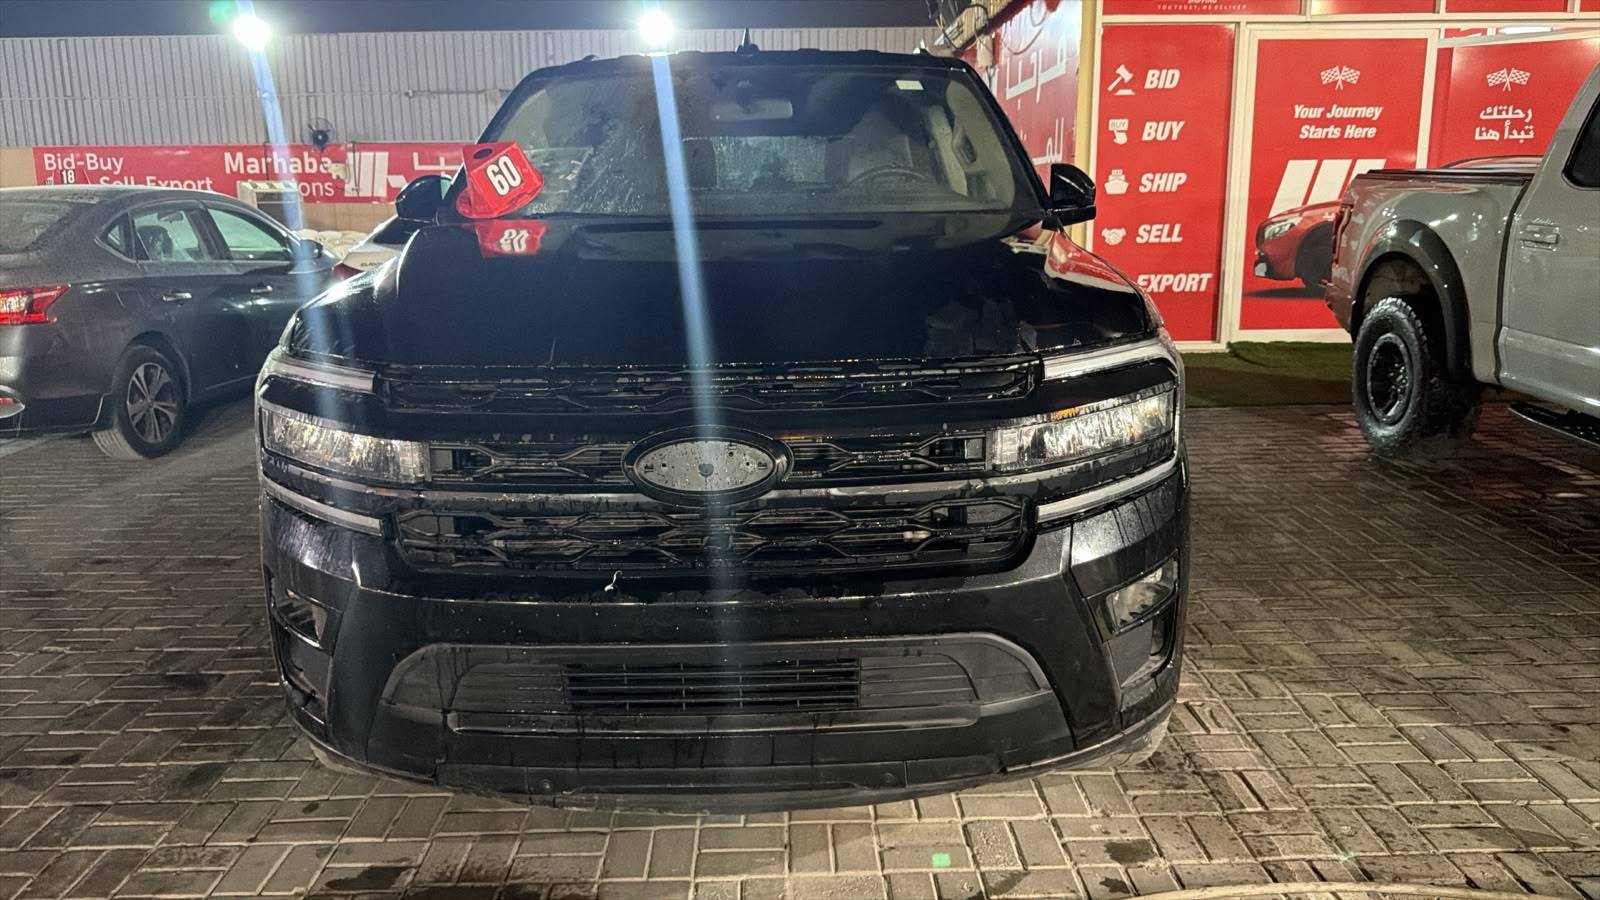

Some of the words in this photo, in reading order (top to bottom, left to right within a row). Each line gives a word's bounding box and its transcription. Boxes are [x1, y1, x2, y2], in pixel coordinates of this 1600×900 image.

[1143, 68, 1181, 89] BID
[1294, 104, 1325, 119] Your
[1326, 104, 1384, 121] Journey
[1479, 104, 1533, 123] رحلتك
[1141, 120, 1185, 141] BUY
[1299, 124, 1341, 139] Starts
[1343, 124, 1377, 139] Here
[1474, 126, 1500, 141] هنا
[1504, 119, 1535, 144] تبدأ
[43, 153, 124, 178] Bid-Buy
[486, 154, 522, 196] 60
[61, 170, 76, 184] 18
[1138, 172, 1187, 193] SHIP
[1135, 224, 1183, 244] SELL
[1136, 273, 1213, 293] EXPORT
